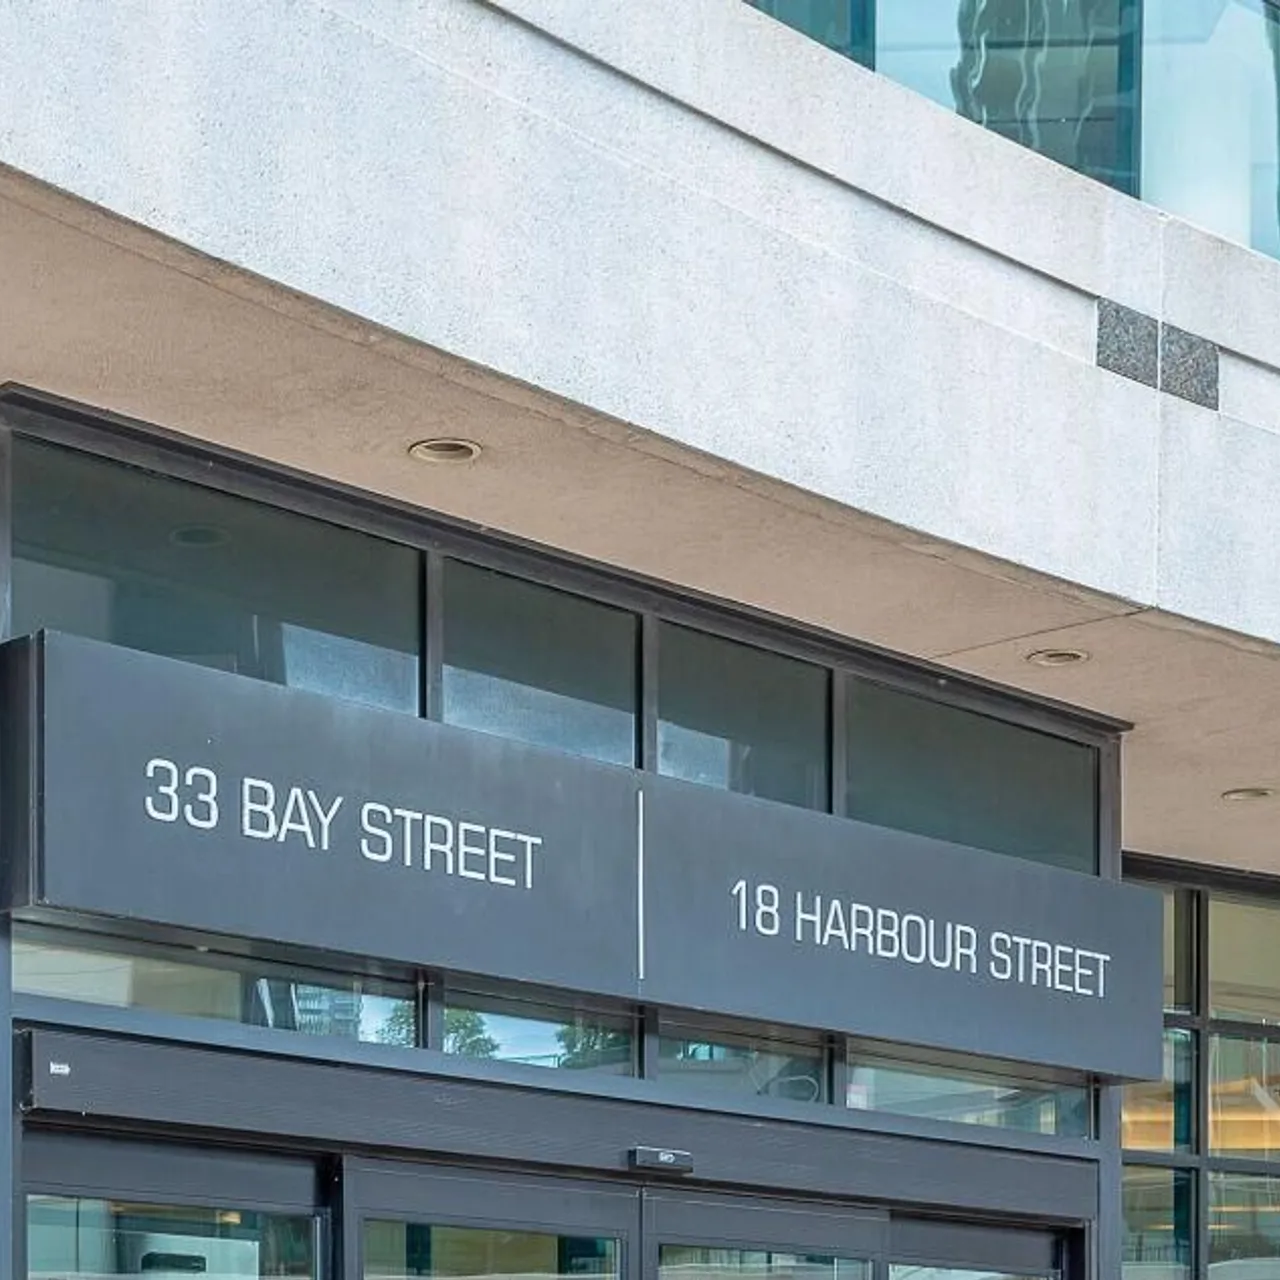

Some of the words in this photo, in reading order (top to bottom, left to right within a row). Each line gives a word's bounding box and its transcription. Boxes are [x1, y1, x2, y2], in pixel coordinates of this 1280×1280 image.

[145, 758, 219, 830] 33
[242, 777, 344, 851] BAY
[360, 802, 543, 890] STREET
[731, 879, 781, 936] 18
[795, 891, 977, 975] HARBOUR
[989, 931, 1111, 998] STREET
